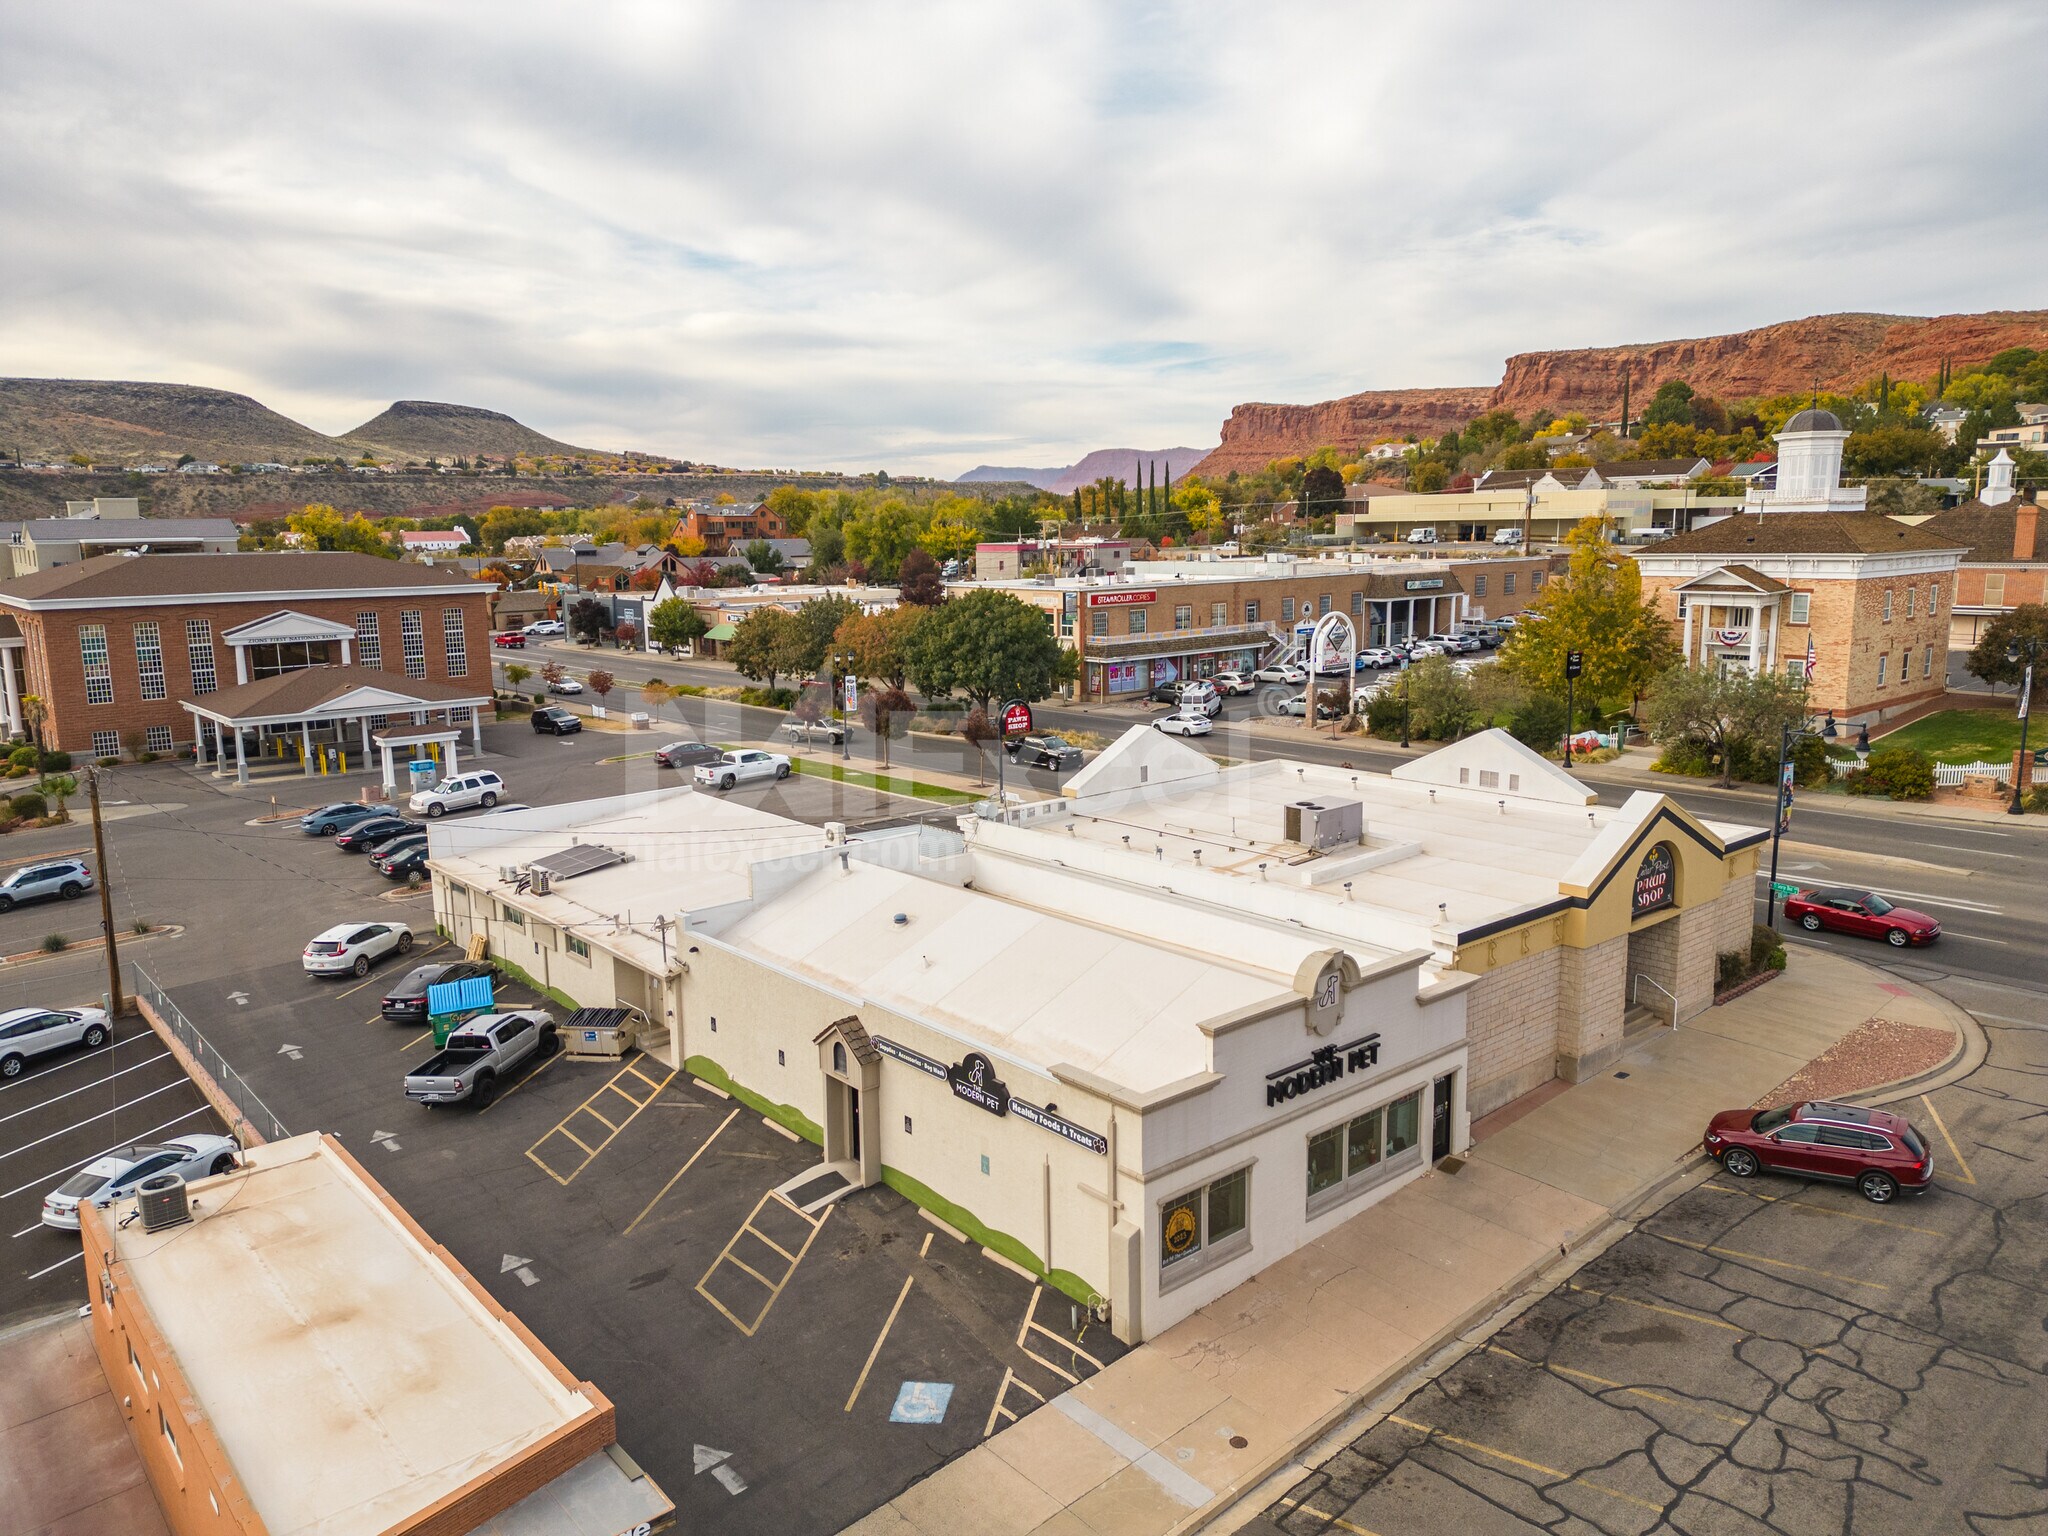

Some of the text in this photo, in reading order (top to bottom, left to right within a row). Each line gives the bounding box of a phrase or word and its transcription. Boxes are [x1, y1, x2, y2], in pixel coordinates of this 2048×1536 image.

[1098, 593, 1150, 604] STEAMROLLER COPIES
[1007, 715, 1028, 724] PAWN
[1007, 722, 1028, 730] SHOP
[880, 1042, 945, 1077] Supplies Accessories Dog Wash
[1266, 1042, 1381, 1107] MODERN PET
[956, 1083, 999, 1110] MODERN PET
[973, 1084, 982, 1093] THE
[1012, 1102, 1092, 1147] Healthy Foods & Treats
